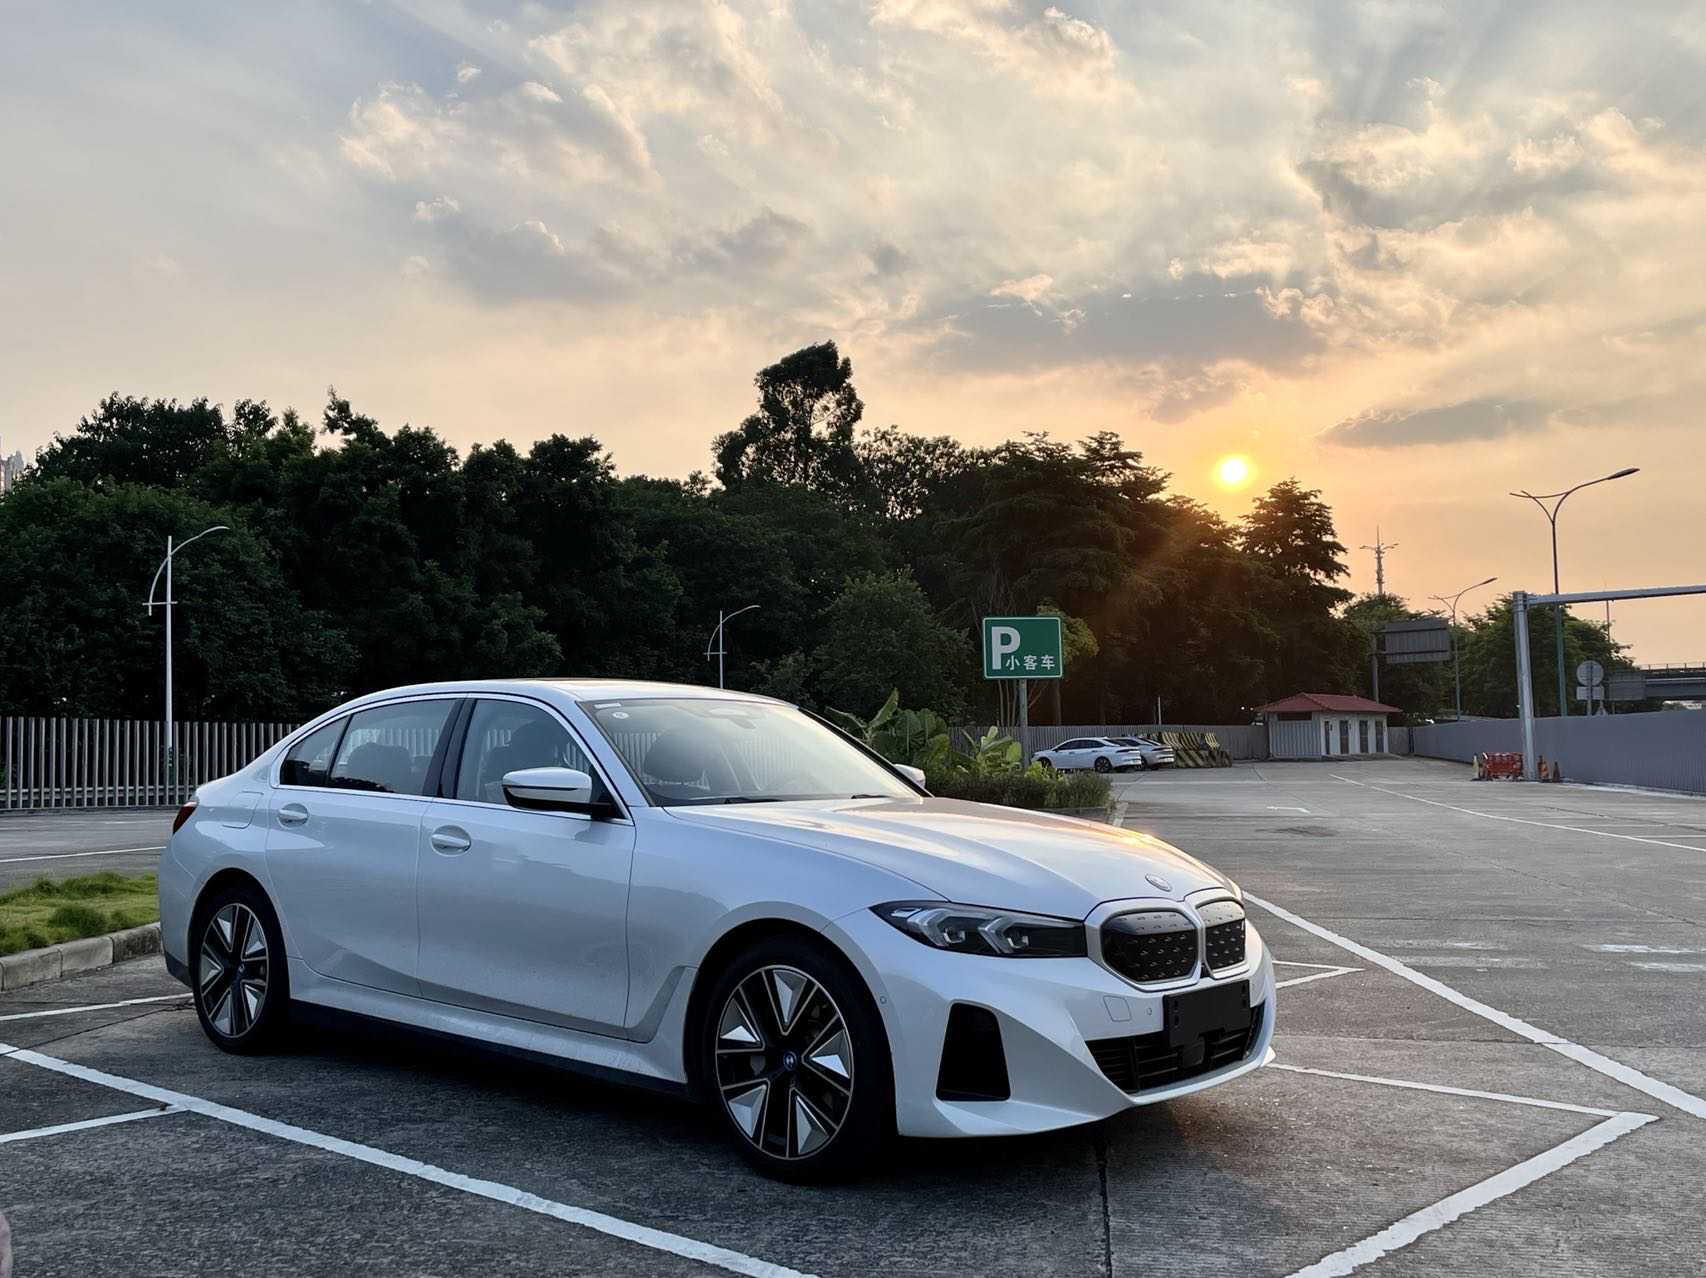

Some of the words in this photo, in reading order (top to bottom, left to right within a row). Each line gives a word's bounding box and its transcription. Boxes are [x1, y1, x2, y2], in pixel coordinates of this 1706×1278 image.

[991, 626, 1021, 670] P
[1005, 654, 1055, 670] 小客车
